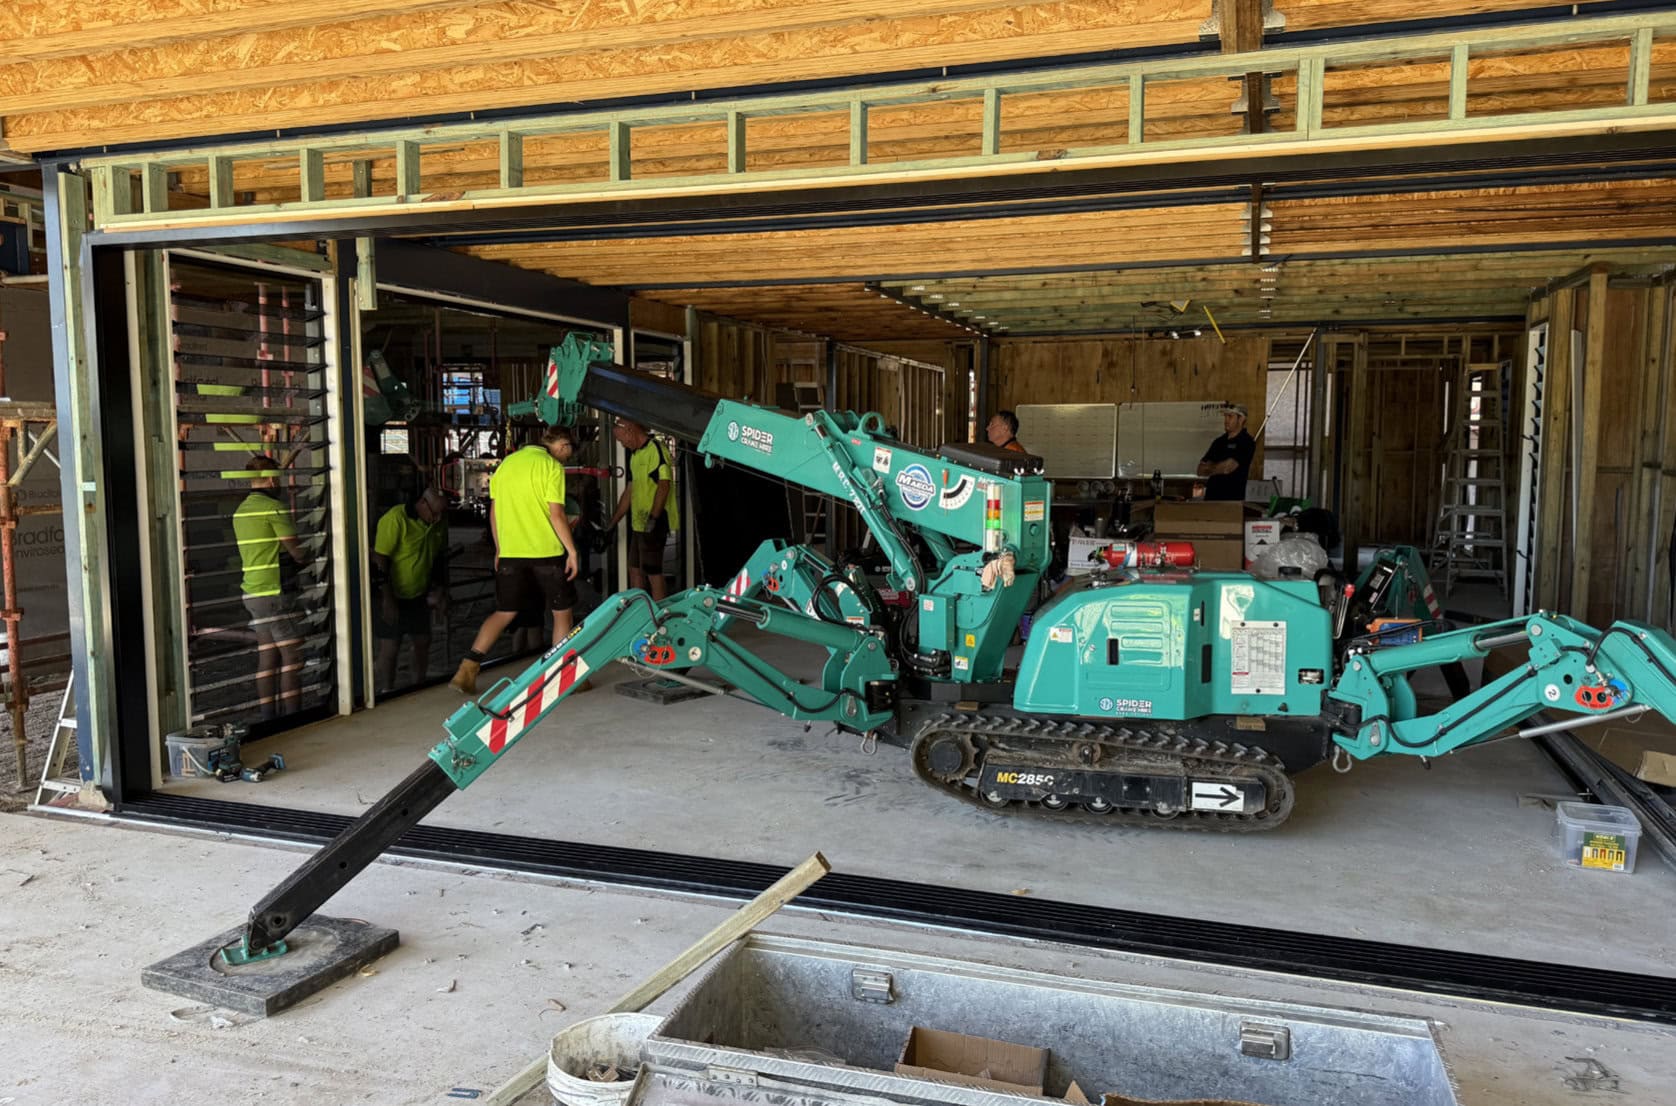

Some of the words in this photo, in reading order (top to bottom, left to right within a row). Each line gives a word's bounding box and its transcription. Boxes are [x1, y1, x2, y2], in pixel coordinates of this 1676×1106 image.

[742, 425, 773, 444] SPIDER
[1116, 699, 1152, 708] SPIDER
[996, 772, 1055, 786] MC285C
